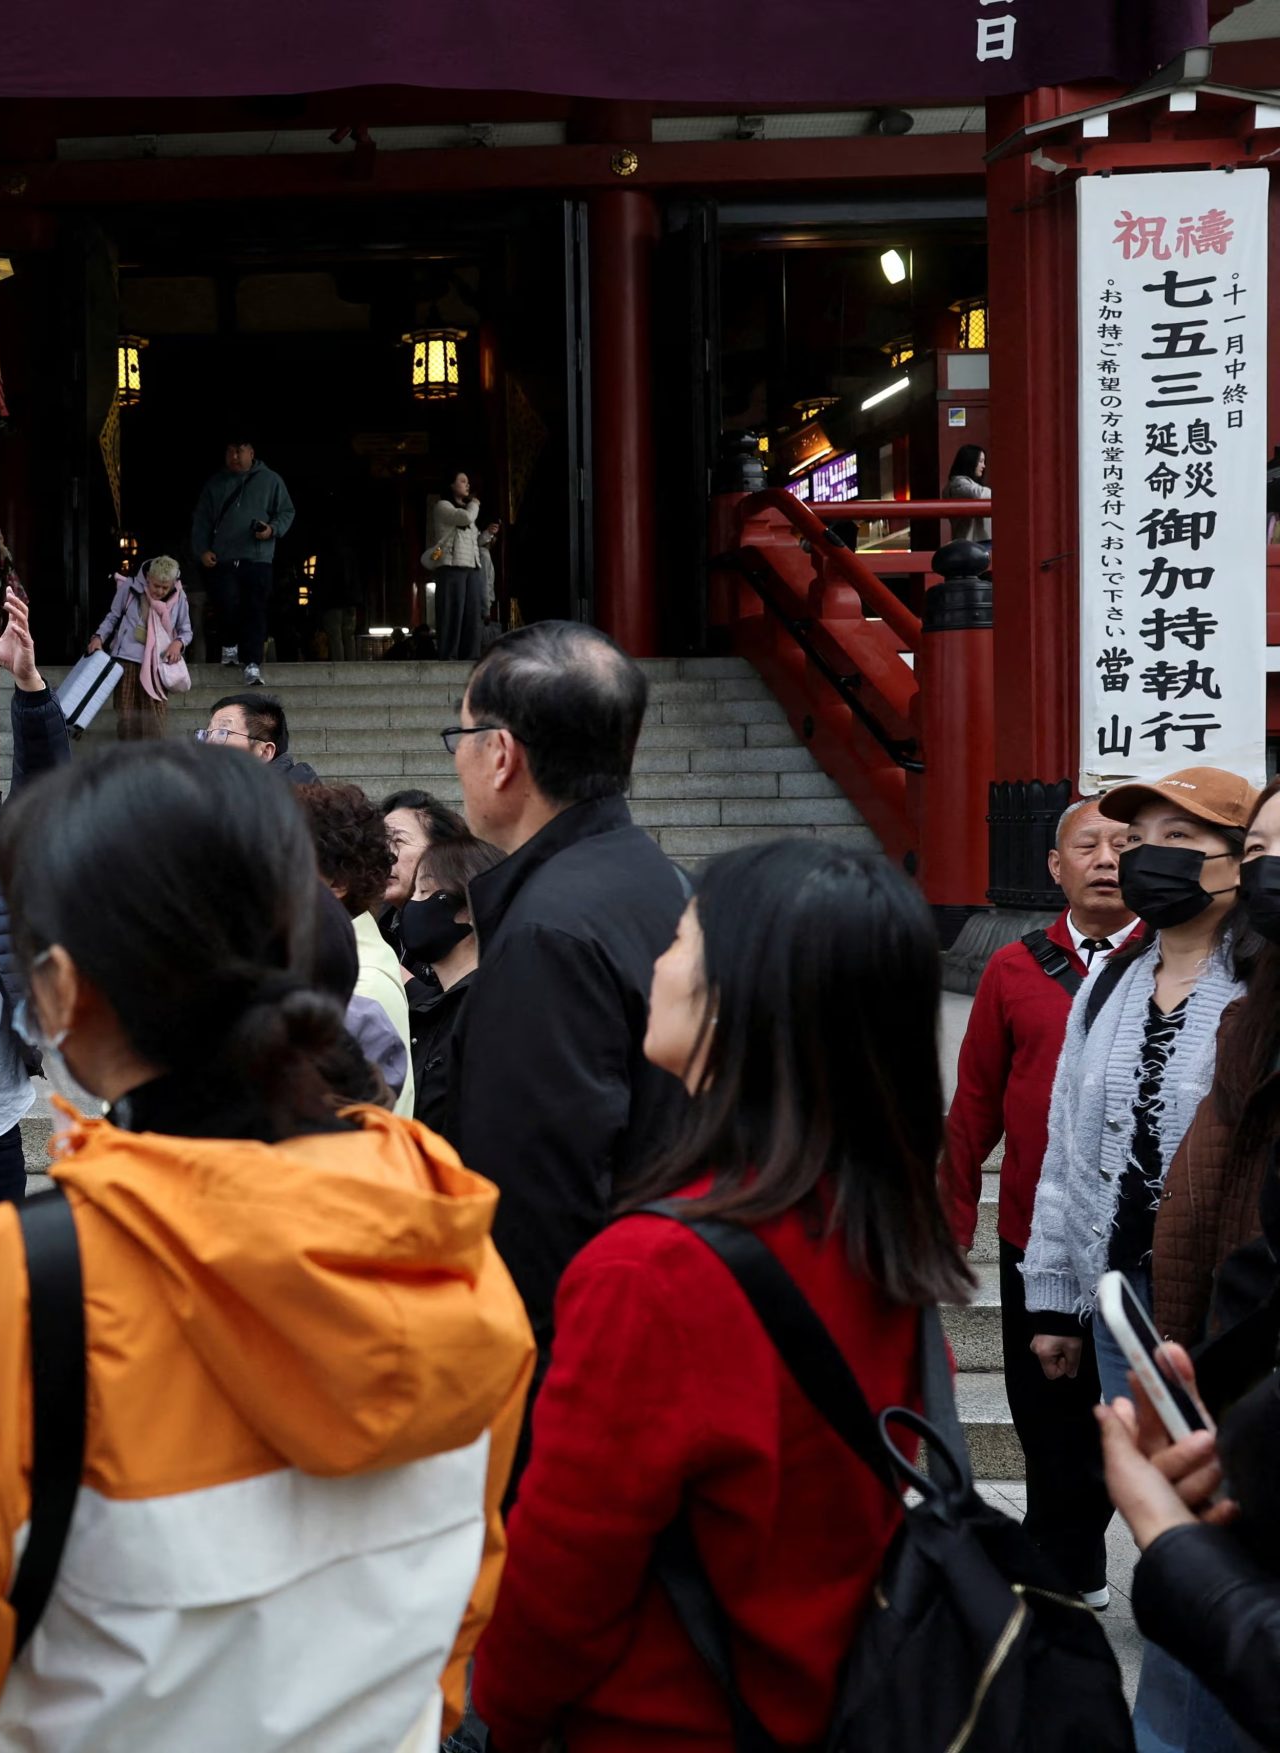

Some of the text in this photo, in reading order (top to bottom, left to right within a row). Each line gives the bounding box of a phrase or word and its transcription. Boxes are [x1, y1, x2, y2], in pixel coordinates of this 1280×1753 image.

[976, 0, 1017, 62] 日
[1141, 270, 1218, 409] 七五三
[1144, 421, 1181, 500] 延命
[1181, 417, 1218, 499] 息災
[1135, 507, 1222, 752] 御加持執行
[1095, 646, 1134, 758] 當山
